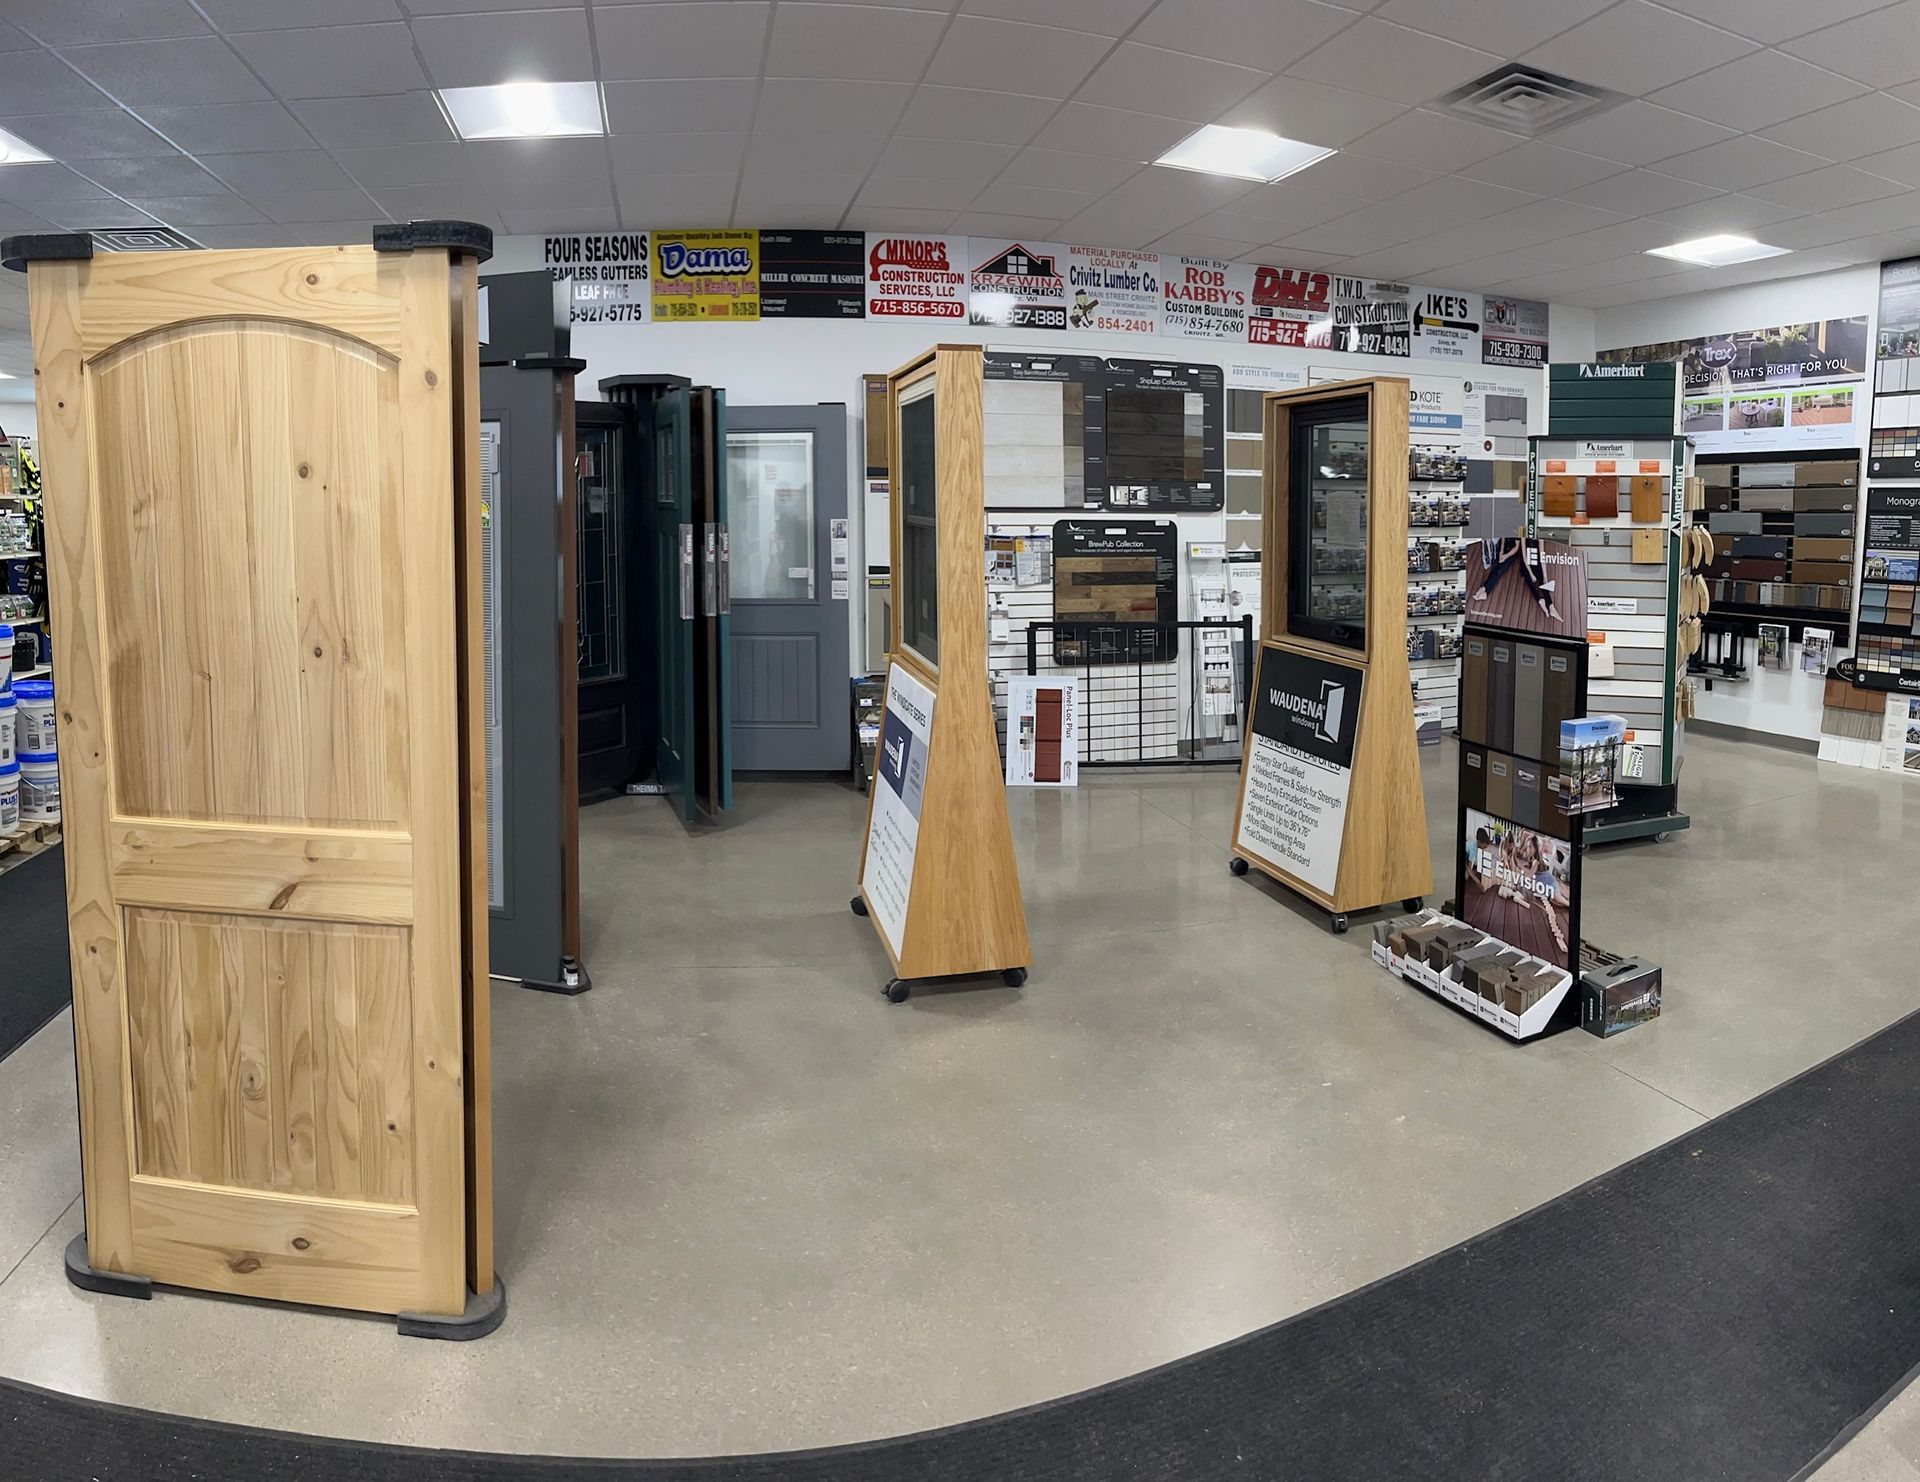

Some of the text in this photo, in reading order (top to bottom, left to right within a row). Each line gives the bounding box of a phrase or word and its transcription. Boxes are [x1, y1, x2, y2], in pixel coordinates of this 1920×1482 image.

[545, 235, 648, 263] FOUR SEASONS
[886, 239, 947, 261] MINOR'S
[1070, 246, 1159, 263] MATERIAL PURCHASED
[660, 243, 751, 276] Dama
[1090, 258, 1138, 269] LOCALLY At
[1181, 257, 1229, 270] Built By
[546, 264, 648, 282] EAMLESS GUTTERS
[761, 273, 864, 284] MILLER CONCRETE MASONRY
[882, 270, 964, 284] CONSTRUCTION
[971, 273, 1063, 288] KRZEWINA
[1069, 265, 1159, 293] Crivitz Lumber Co.
[1186, 267, 1225, 287] ROB
[574, 284, 600, 300] LEAF
[880, 284, 955, 298] SERVICES, LLC
[972, 284, 1064, 297] CONSTRUCTION
[1165, 281, 1246, 306] KABBY'S
[1252, 266, 1329, 303] DW3
[1335, 278, 1366, 299] T.W.D.
[1105, 291, 1129, 301] STREET
[874, 301, 960, 315] 715-856-5670
[1335, 301, 1408, 325] CONSTRUCTION
[1427, 294, 1468, 319] IKE'S
[1097, 317, 1155, 333] 854-2401
[1165, 315, 1244, 333] (715) 854-7680
[1339, 331, 1409, 356] 71-927-0434
[1489, 341, 1542, 359] 715-938-7300
[1704, 347, 1733, 362] Trex
[1594, 364, 1645, 378] Amerhart
[1731, 367, 1764, 379] THAT'S
[1767, 363, 1798, 376] RIGHT
[1800, 361, 1822, 373] FOR
[1825, 358, 1848, 370] YOU
[1162, 378, 1188, 387] Collection
[1419, 391, 1441, 403] KOTE
[1429, 416, 1447, 425] SIDING
[1673, 464, 1683, 521] Amerhart
[1088, 540, 1144, 549] BrewPub Collection
[1540, 551, 1580, 566] Envision
[1270, 688, 1324, 721] WAUDENA
[1291, 714, 1315, 730] windows
[1256, 751, 1305, 779] Energy Star Qualified
[632, 784, 658, 793] THERMA
[1255, 764, 1341, 808] Welded Frames & Sash for Strength
[1253, 777, 1321, 814] Heavy Duty Extruded Screen
[1249, 801, 1289, 828] Single Units Up to
[1251, 788, 1319, 828] Seven Exterior Color Options
[1247, 813, 1305, 850] More Glass Viewing Area
[1246, 825, 1310, 867] Fold Down Handle Standard
[1496, 860, 1555, 900] Envision
